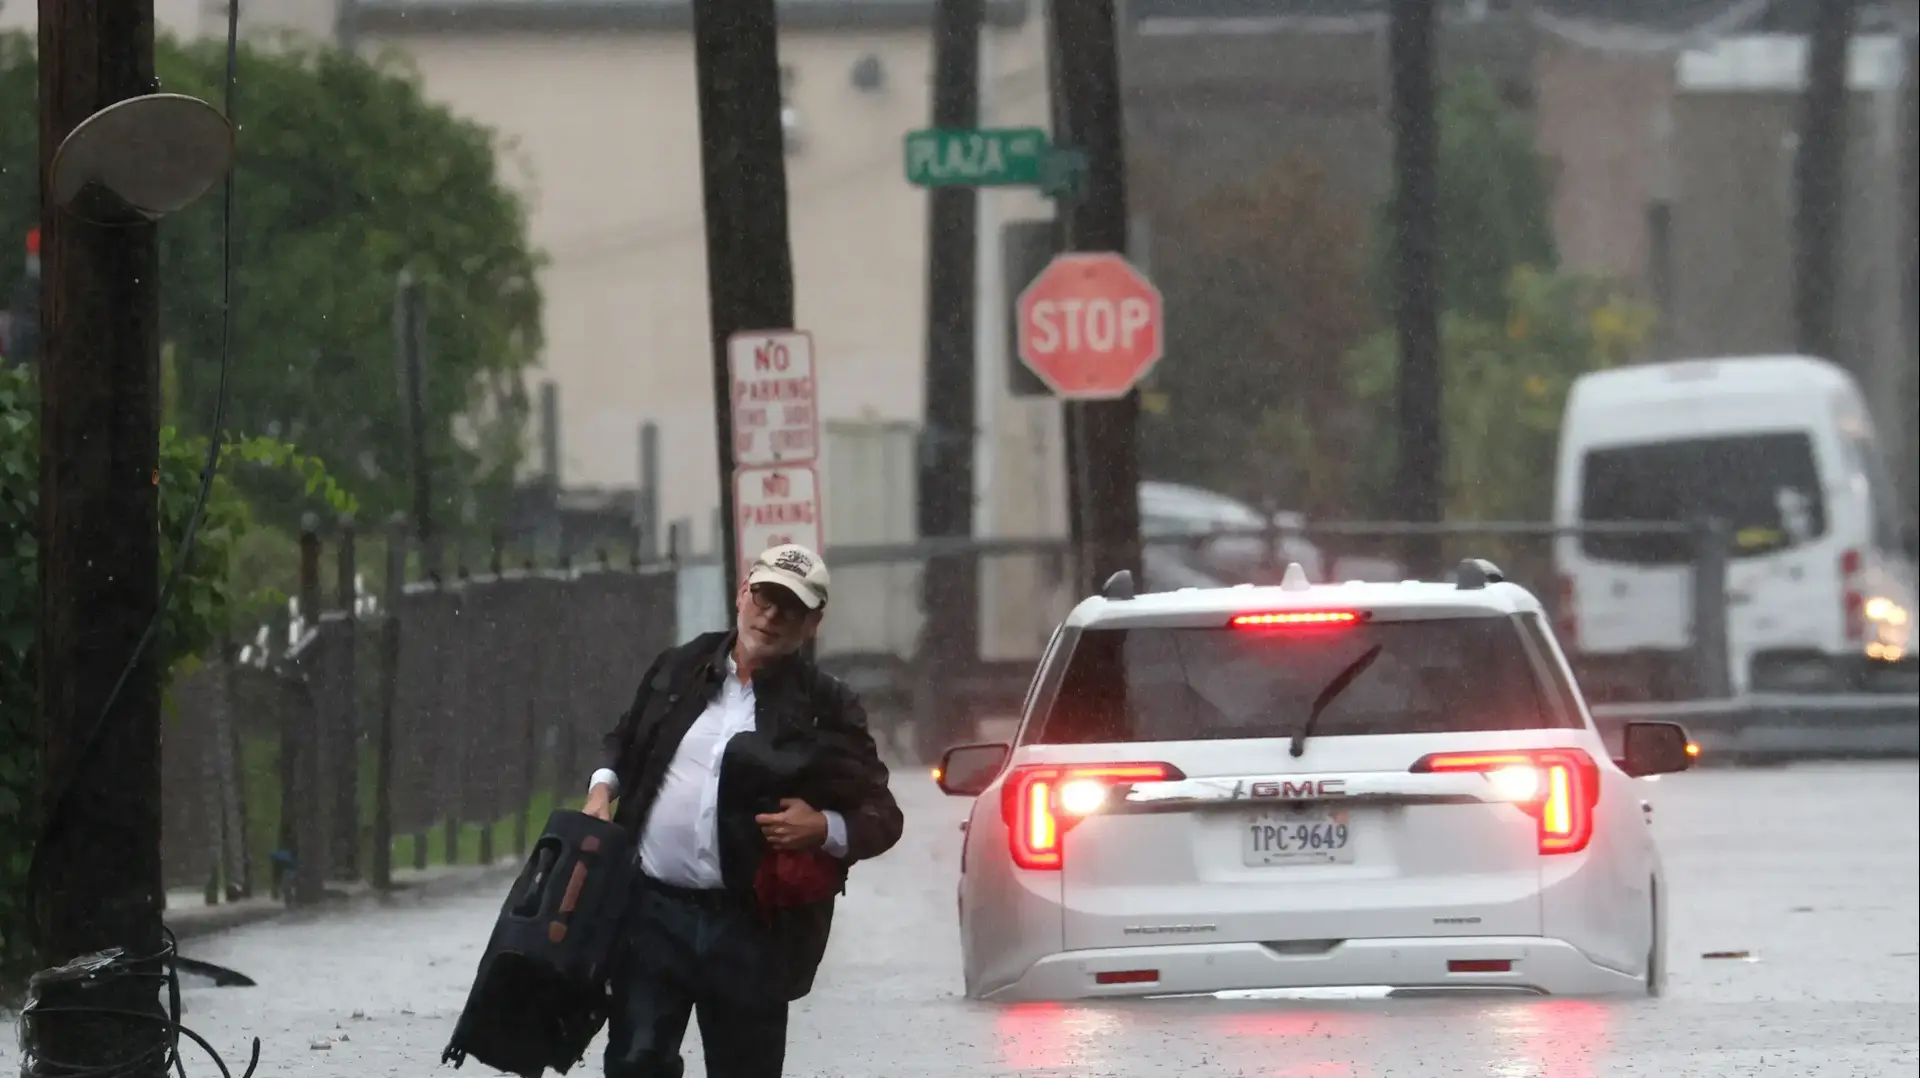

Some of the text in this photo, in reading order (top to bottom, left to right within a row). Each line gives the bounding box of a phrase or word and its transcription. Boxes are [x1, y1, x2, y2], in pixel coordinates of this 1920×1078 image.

[911, 134, 1007, 178] PLAZA
[1030, 296, 1150, 353] STOP
[753, 343, 790, 371] NO
[734, 378, 813, 402] PARKING
[762, 472, 790, 498] NO
[741, 501, 814, 526] PARKING
[1251, 779, 1346, 798] GMC
[1250, 823, 1349, 852] TPC-9649
